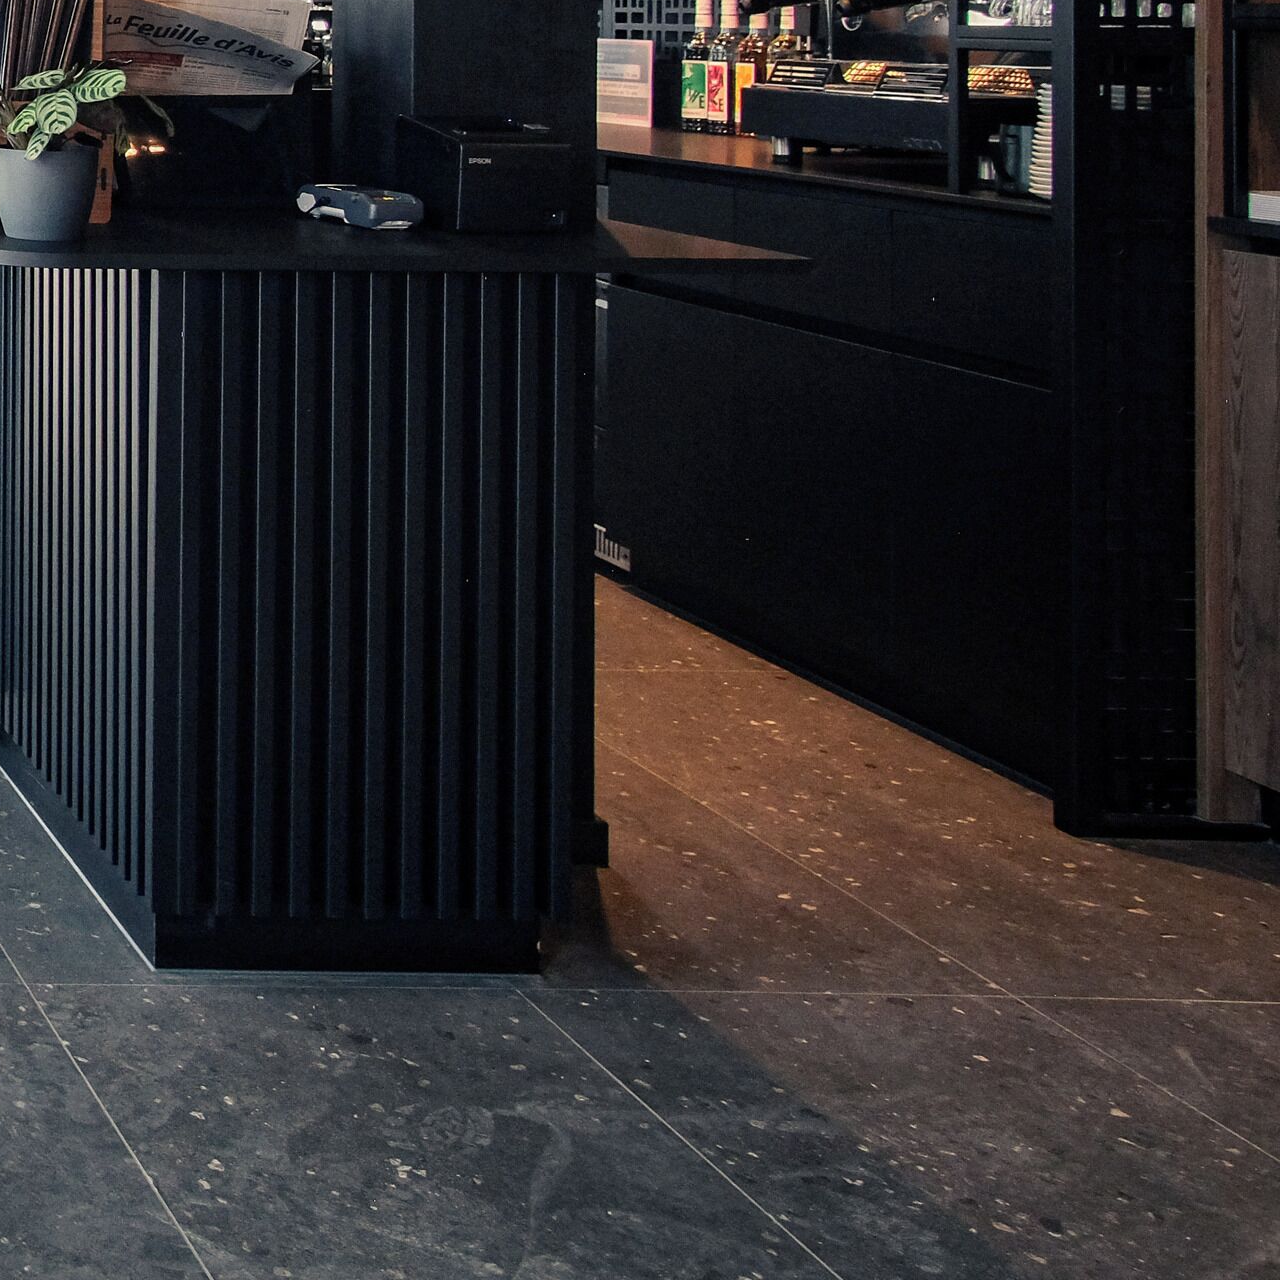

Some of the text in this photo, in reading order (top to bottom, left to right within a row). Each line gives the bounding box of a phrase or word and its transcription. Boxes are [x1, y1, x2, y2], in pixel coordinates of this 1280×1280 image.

[123, 15, 210, 46] Feuille
[214, 39, 295, 67] d'Avis
[468, 157, 492, 165] EPSON
